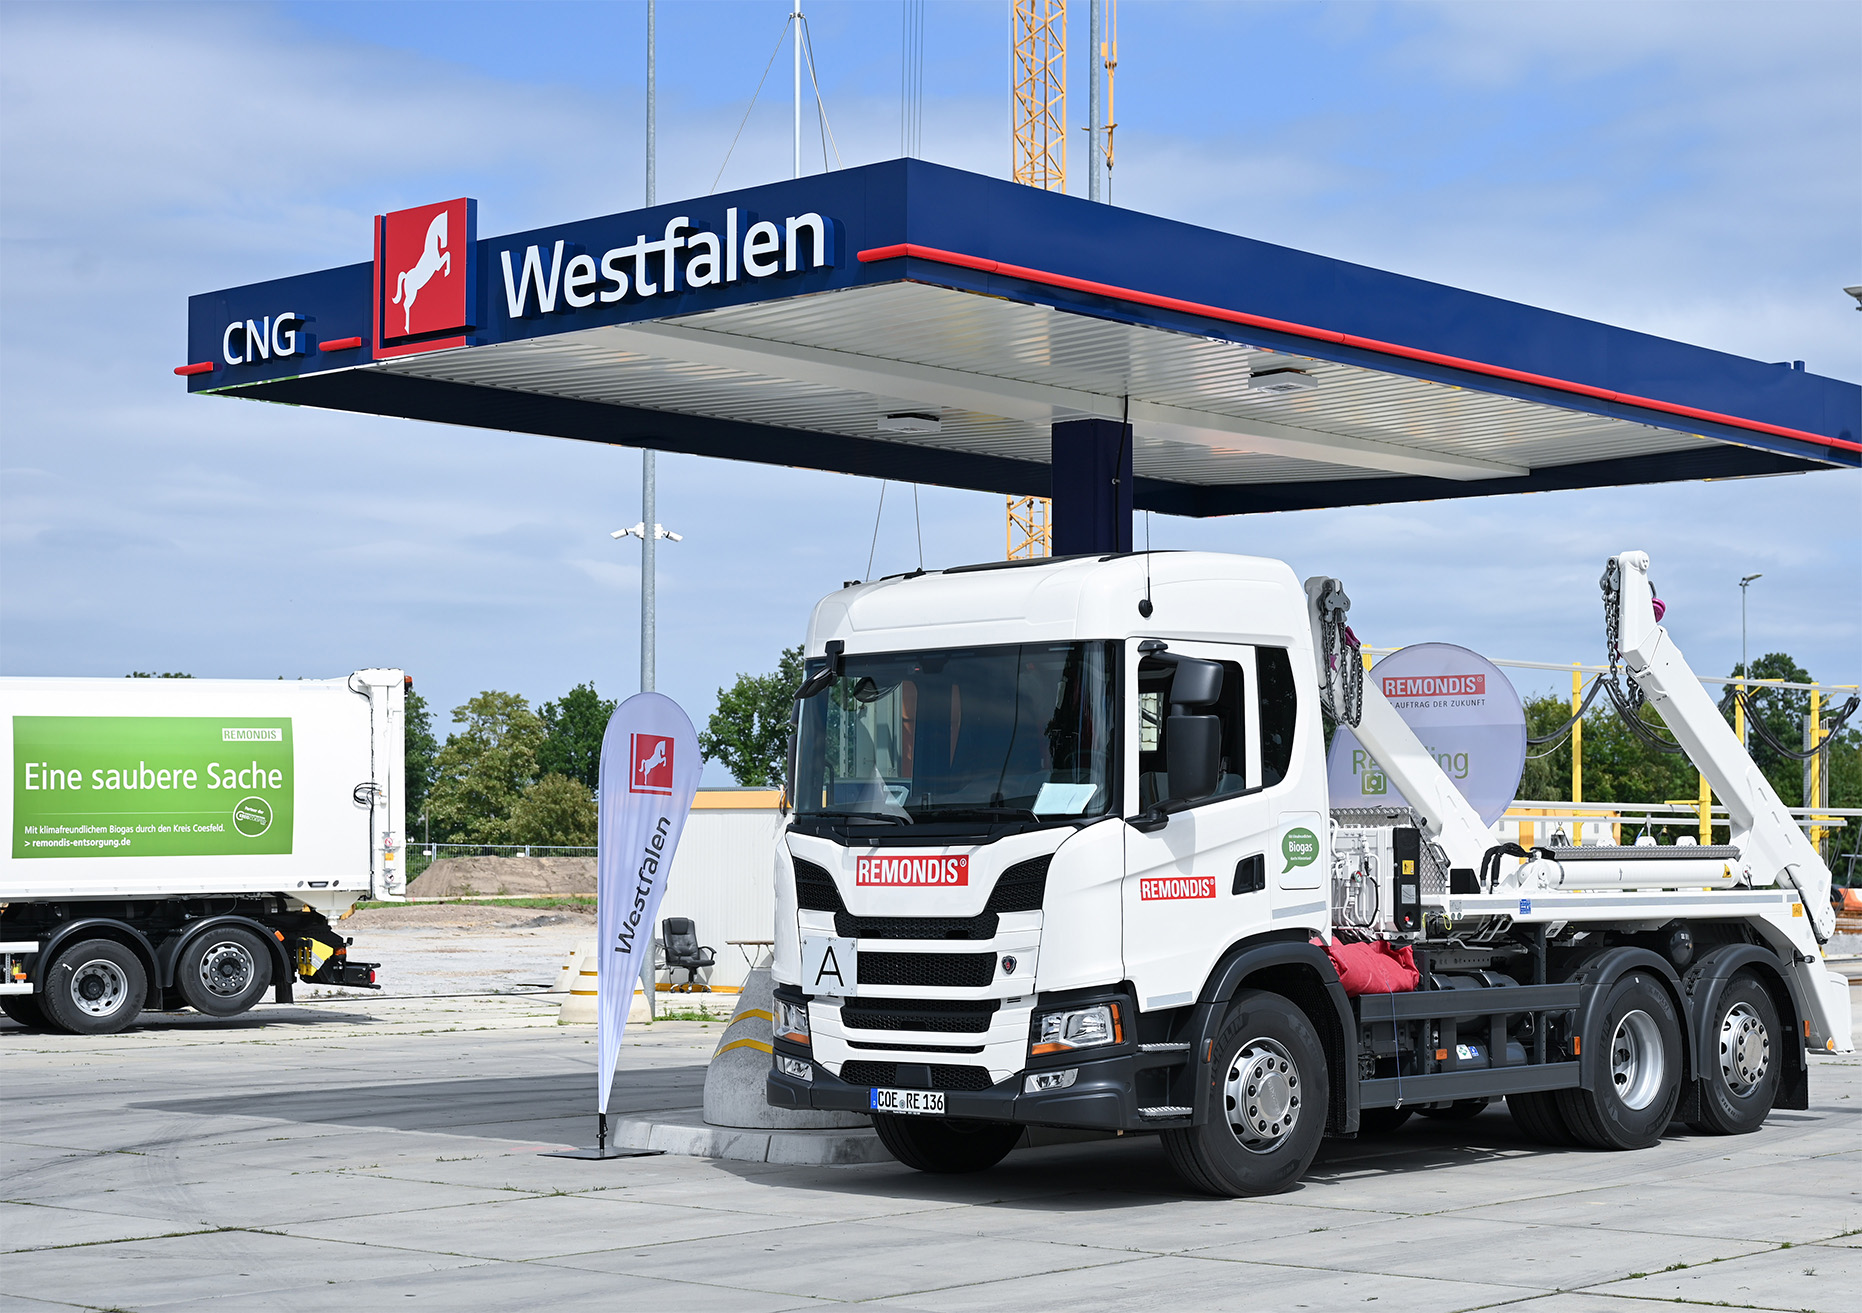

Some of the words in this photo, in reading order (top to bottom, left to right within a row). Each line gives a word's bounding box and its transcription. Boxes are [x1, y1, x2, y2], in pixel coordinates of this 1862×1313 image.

[501, 207, 825, 319] Westfalen
[223, 312, 296, 365] CNG
[1395, 700, 1430, 709] AUFTRAG
[1433, 700, 1448, 708] DER
[1450, 698, 1486, 707] ZUKUNFT
[25, 762, 82, 790] Eine
[91, 760, 198, 790] saubere
[206, 760, 283, 789] Sache
[24, 825, 38, 835] Mit
[39, 825, 108, 835] klimafreundlichem
[109, 825, 134, 836] Biogas
[135, 824, 157, 834] durch
[157, 823, 172, 833] den
[173, 823, 191, 833] Kreis
[192, 822, 226, 833] Coesfeld.
[32, 837, 132, 849] remondis-entsorgung.de
[1288, 840, 1313, 855] Biogas
[614, 816, 671, 954] Westfalen
[815, 945, 844, 987] A
[877, 1090, 898, 1108] COE
[906, 1092, 920, 1110] RE
[922, 1093, 944, 1111] 136
